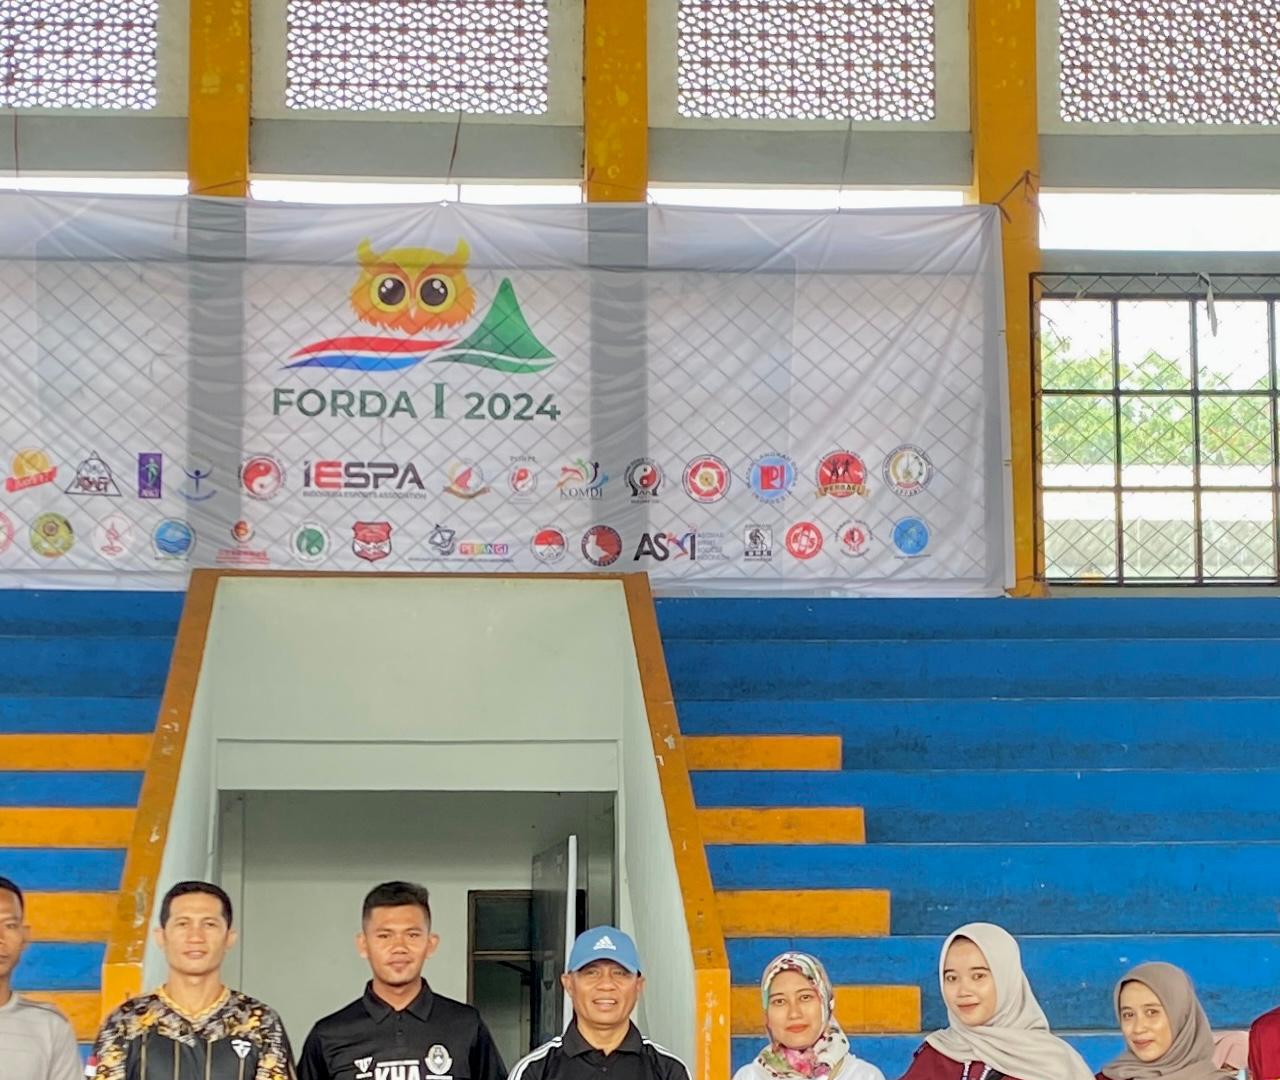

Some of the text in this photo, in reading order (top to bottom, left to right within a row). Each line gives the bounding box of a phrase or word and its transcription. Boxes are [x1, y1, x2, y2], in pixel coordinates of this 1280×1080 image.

[272, 382, 561, 421] FORDA I 2024
